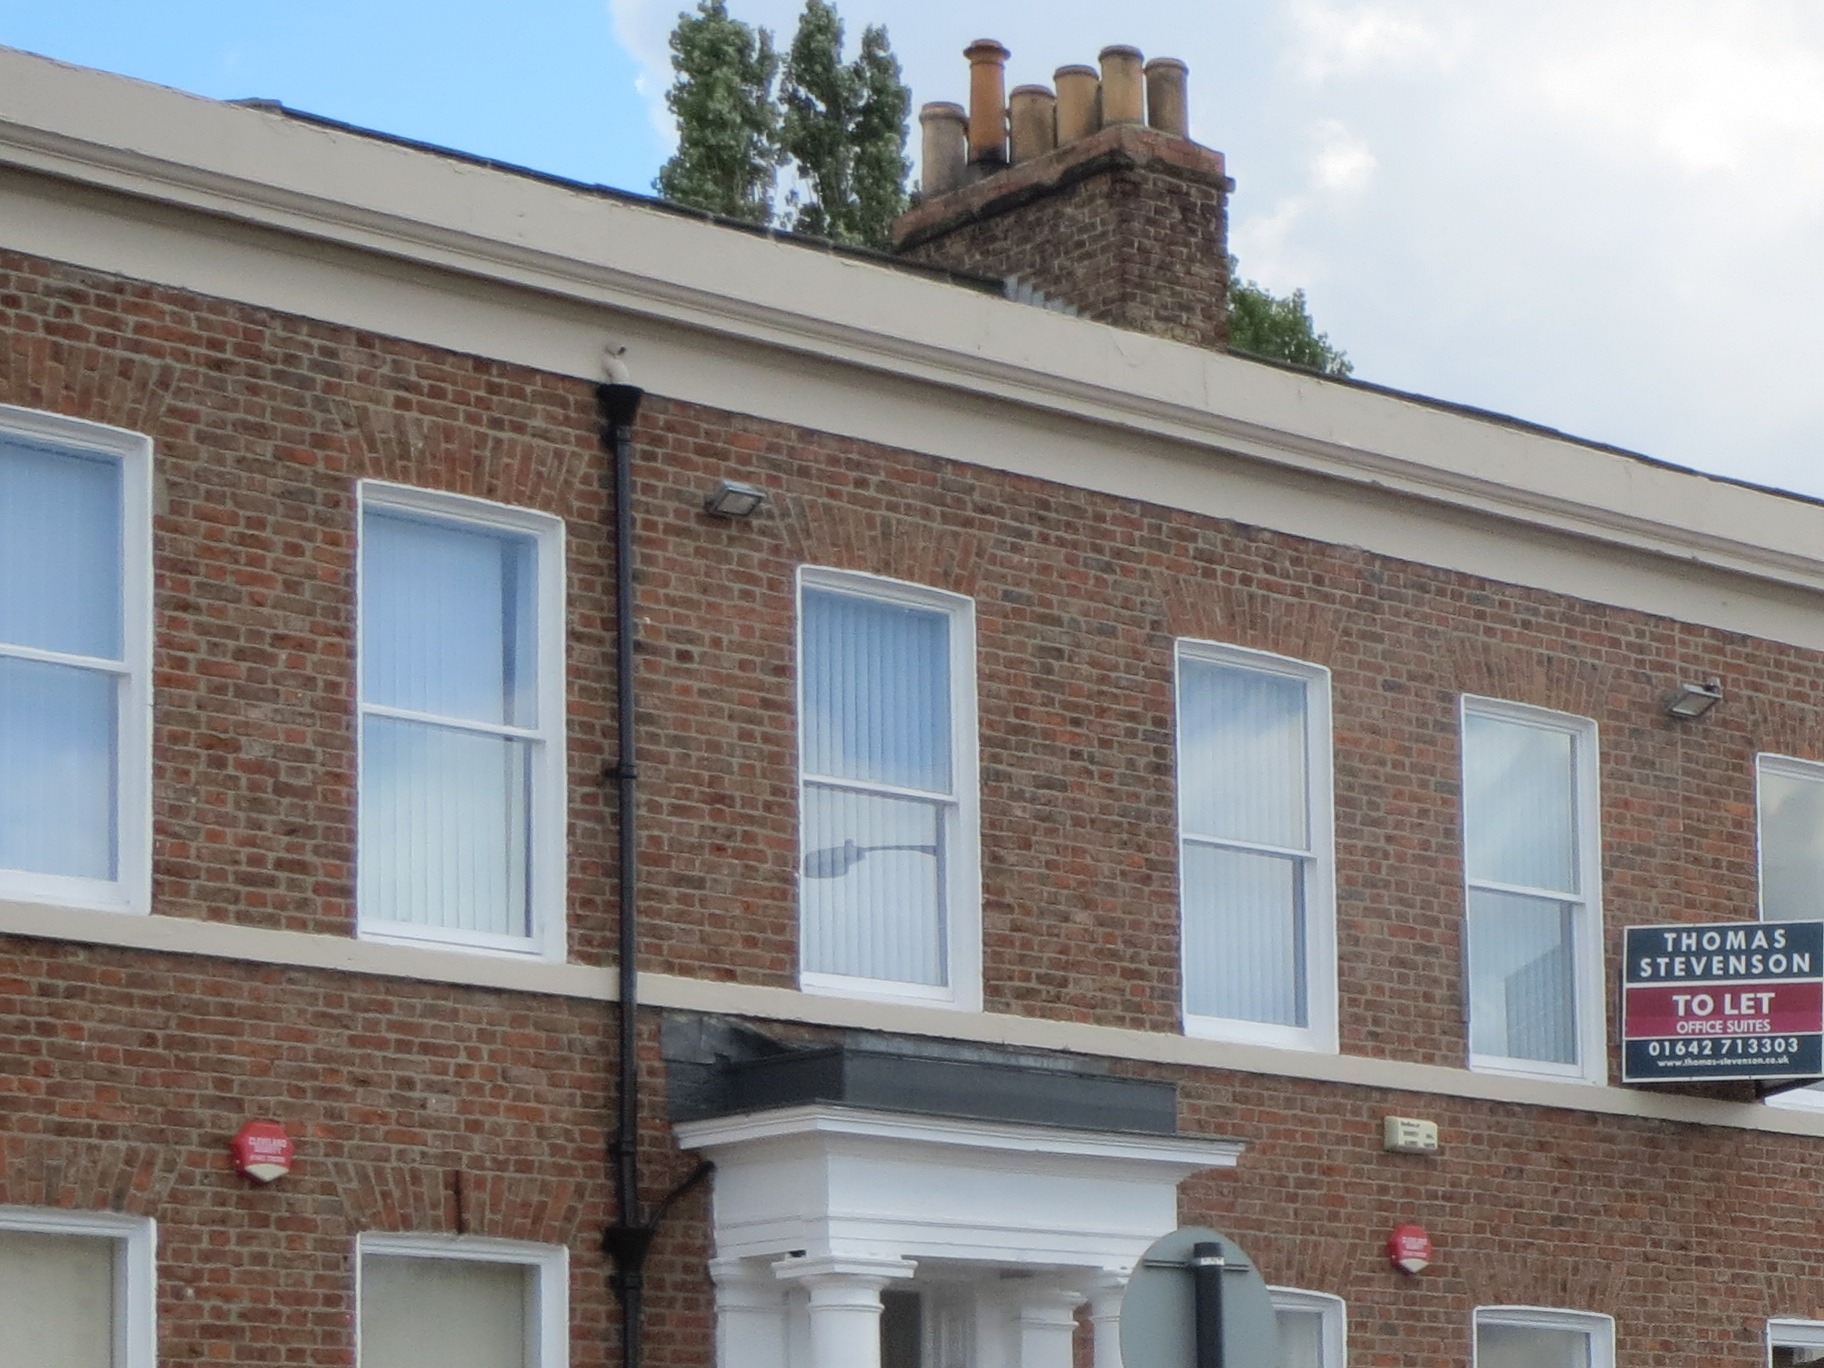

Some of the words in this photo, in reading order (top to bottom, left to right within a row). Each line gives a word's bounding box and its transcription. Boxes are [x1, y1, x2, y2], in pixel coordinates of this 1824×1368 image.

[1664, 928, 1786, 952] THOMAS
[1640, 953, 1810, 977] STEVENSON
[1672, 994, 1714, 1017] TO
[1724, 992, 1776, 1015] LET
[1676, 1021, 1723, 1034] OFFICE
[1726, 1019, 1771, 1032] SUITES
[1649, 1040, 1713, 1056] 01642
[1721, 1038, 1799, 1054] 713303
